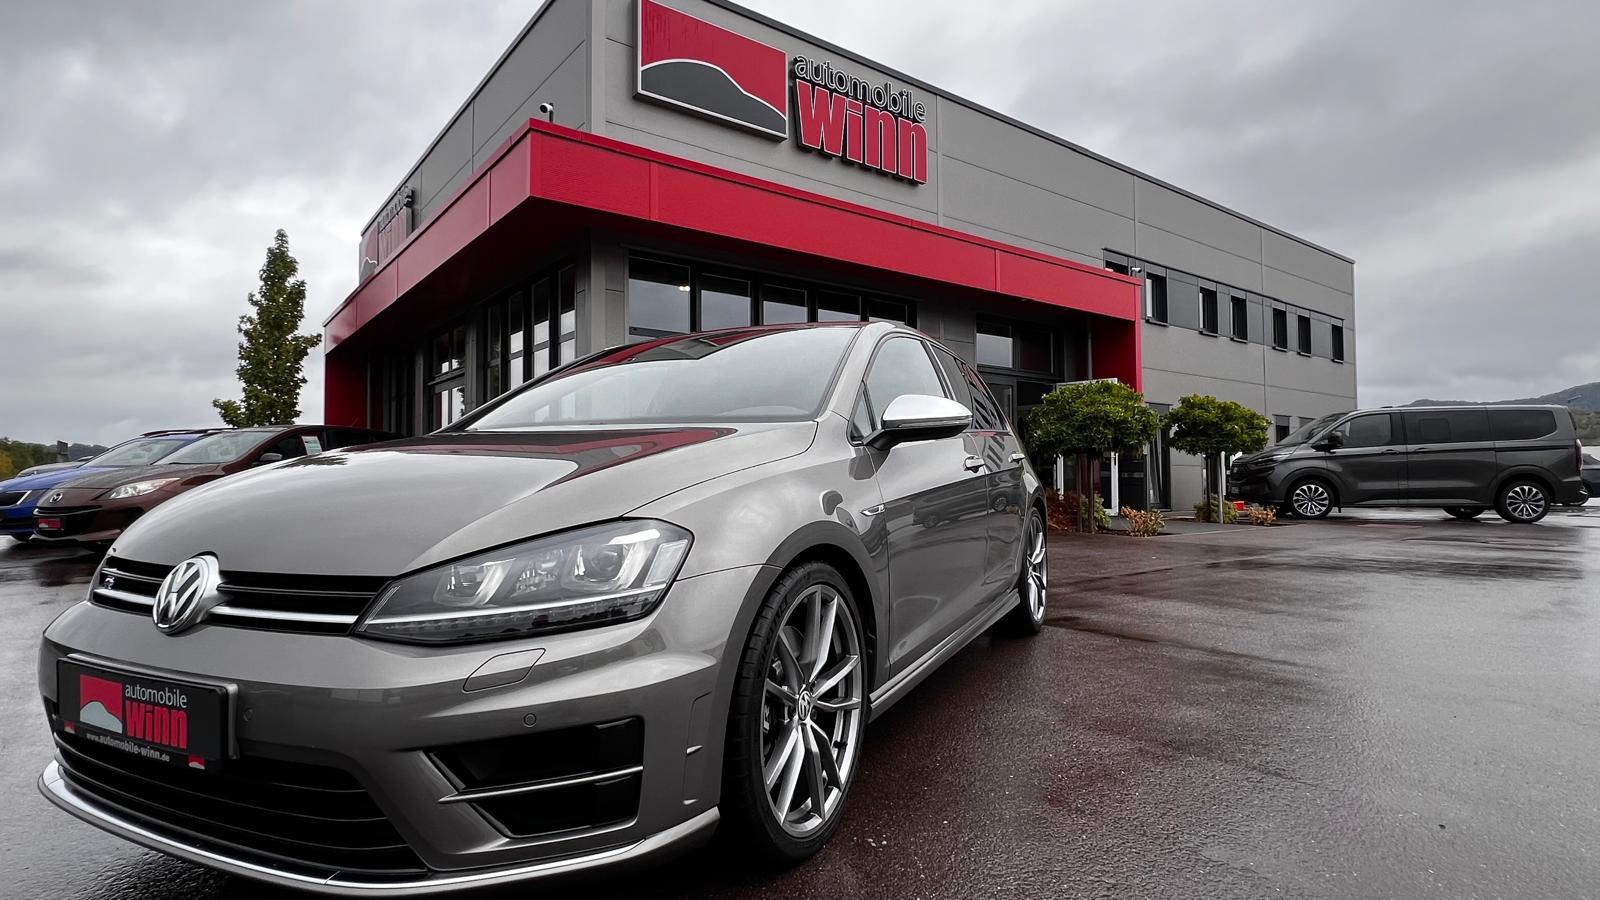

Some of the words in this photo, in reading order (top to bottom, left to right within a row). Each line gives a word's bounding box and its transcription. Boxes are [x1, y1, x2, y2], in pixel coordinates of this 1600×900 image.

[794, 54, 927, 122] automobile
[125, 684, 187, 708] automobile
[86, 732, 170, 763] www.automobile-winn.de
